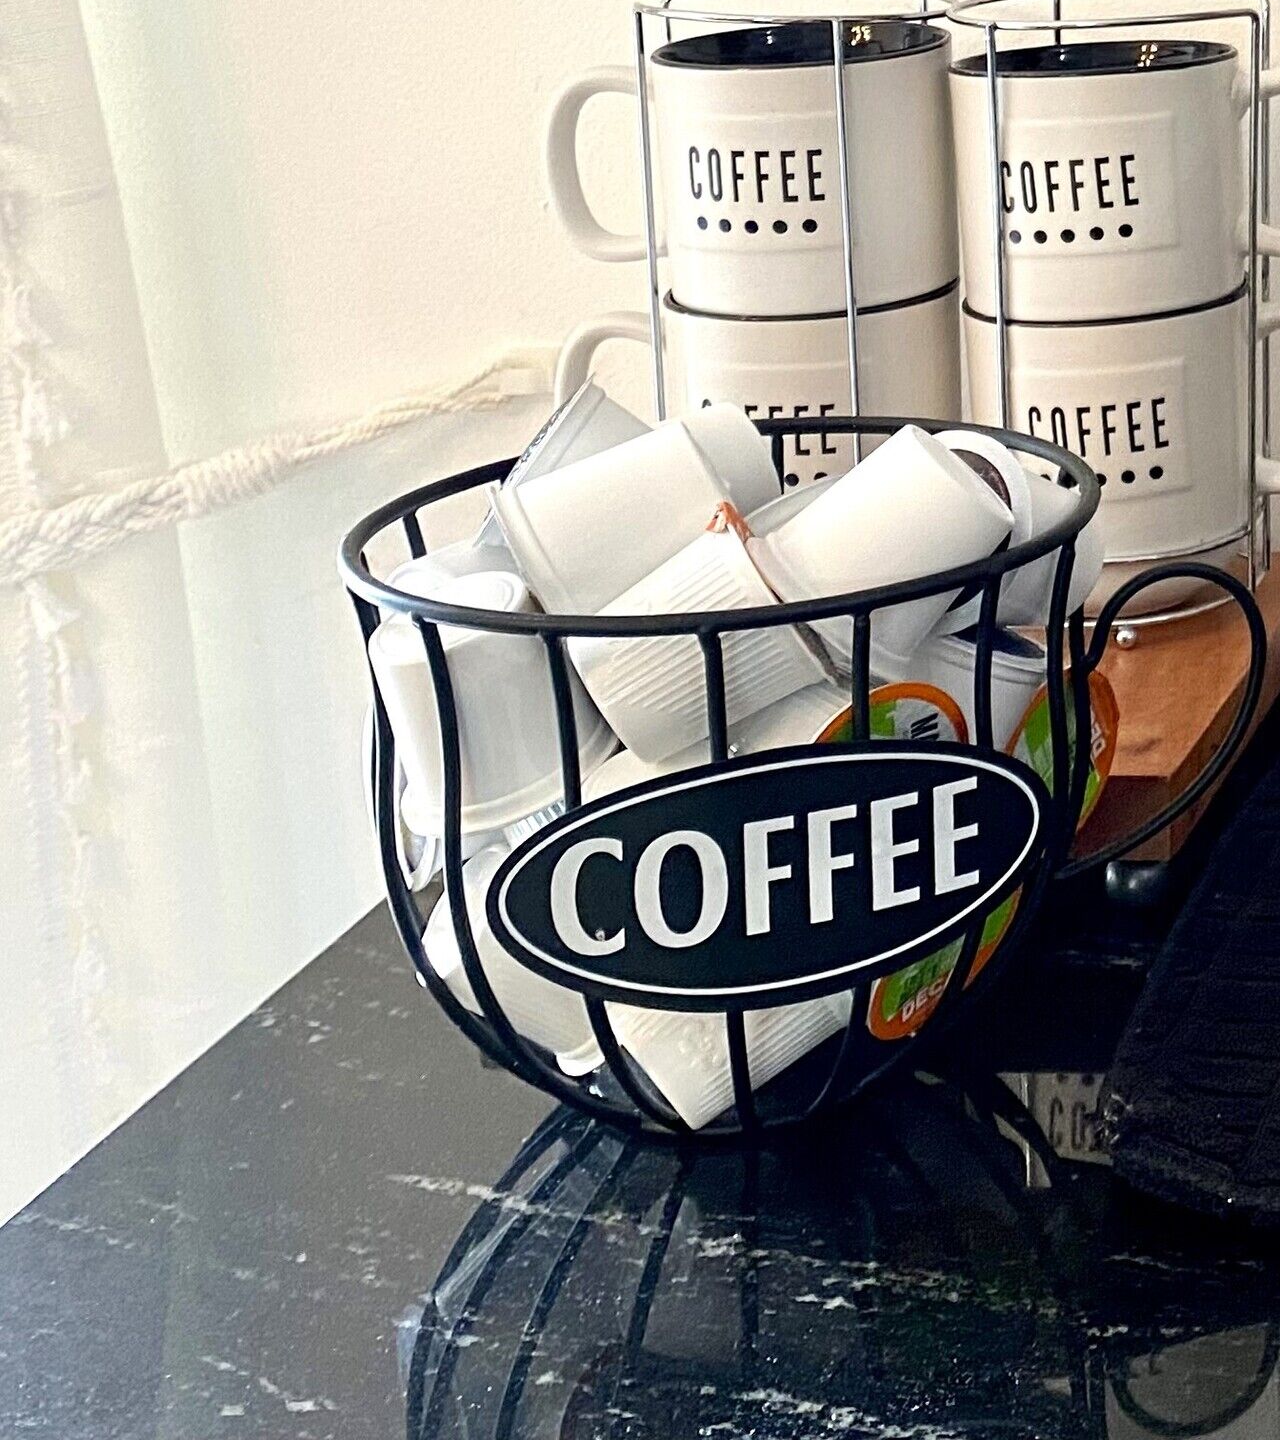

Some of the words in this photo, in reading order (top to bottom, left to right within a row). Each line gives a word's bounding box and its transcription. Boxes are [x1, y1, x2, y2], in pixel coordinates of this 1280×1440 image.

[687, 146, 825, 202] COFFEE
[1000, 154, 1139, 213] COFFEE
[550, 775, 980, 957] COFFEE
